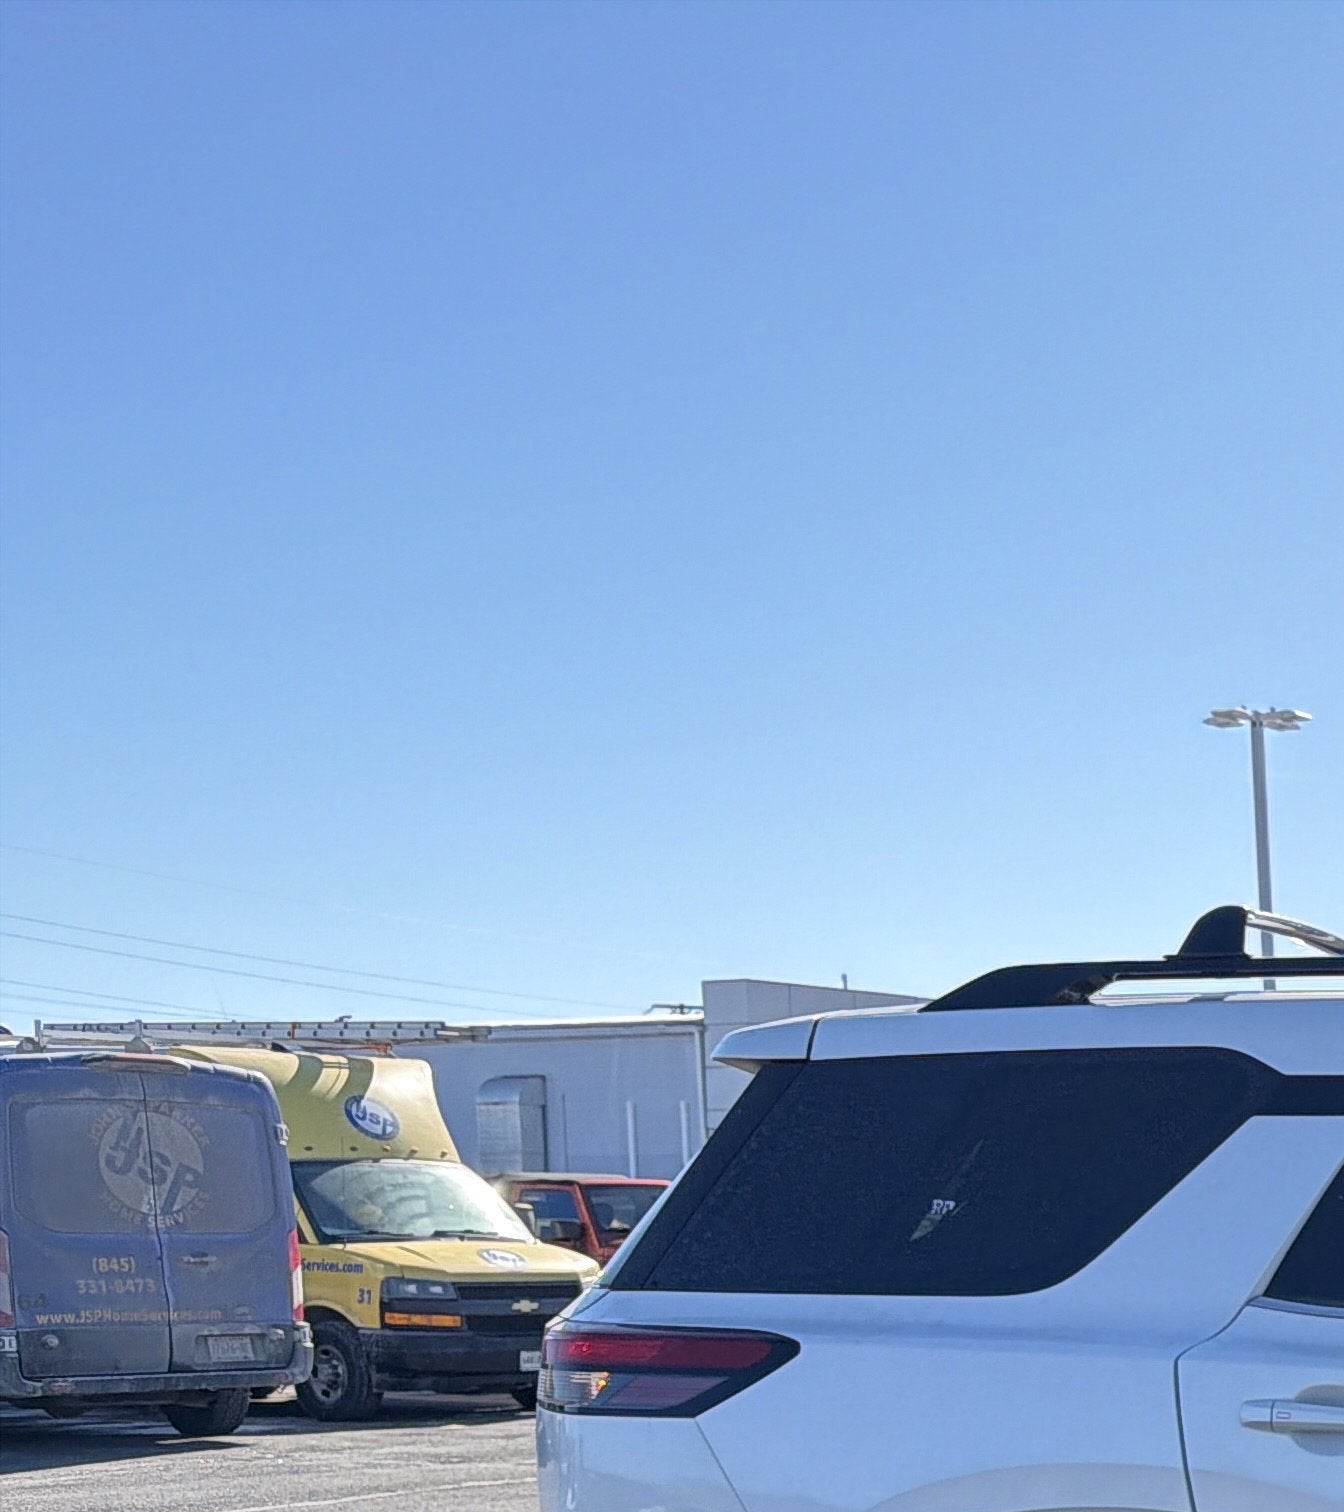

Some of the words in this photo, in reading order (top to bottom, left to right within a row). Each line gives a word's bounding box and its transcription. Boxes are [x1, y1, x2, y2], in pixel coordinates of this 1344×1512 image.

[353, 1099, 396, 1136] JSP
[104, 1106, 204, 1215] JSP
[92, 1255, 136, 1274] (845)
[76, 1278, 157, 1294] 331-8473
[357, 1287, 372, 1305] 31
